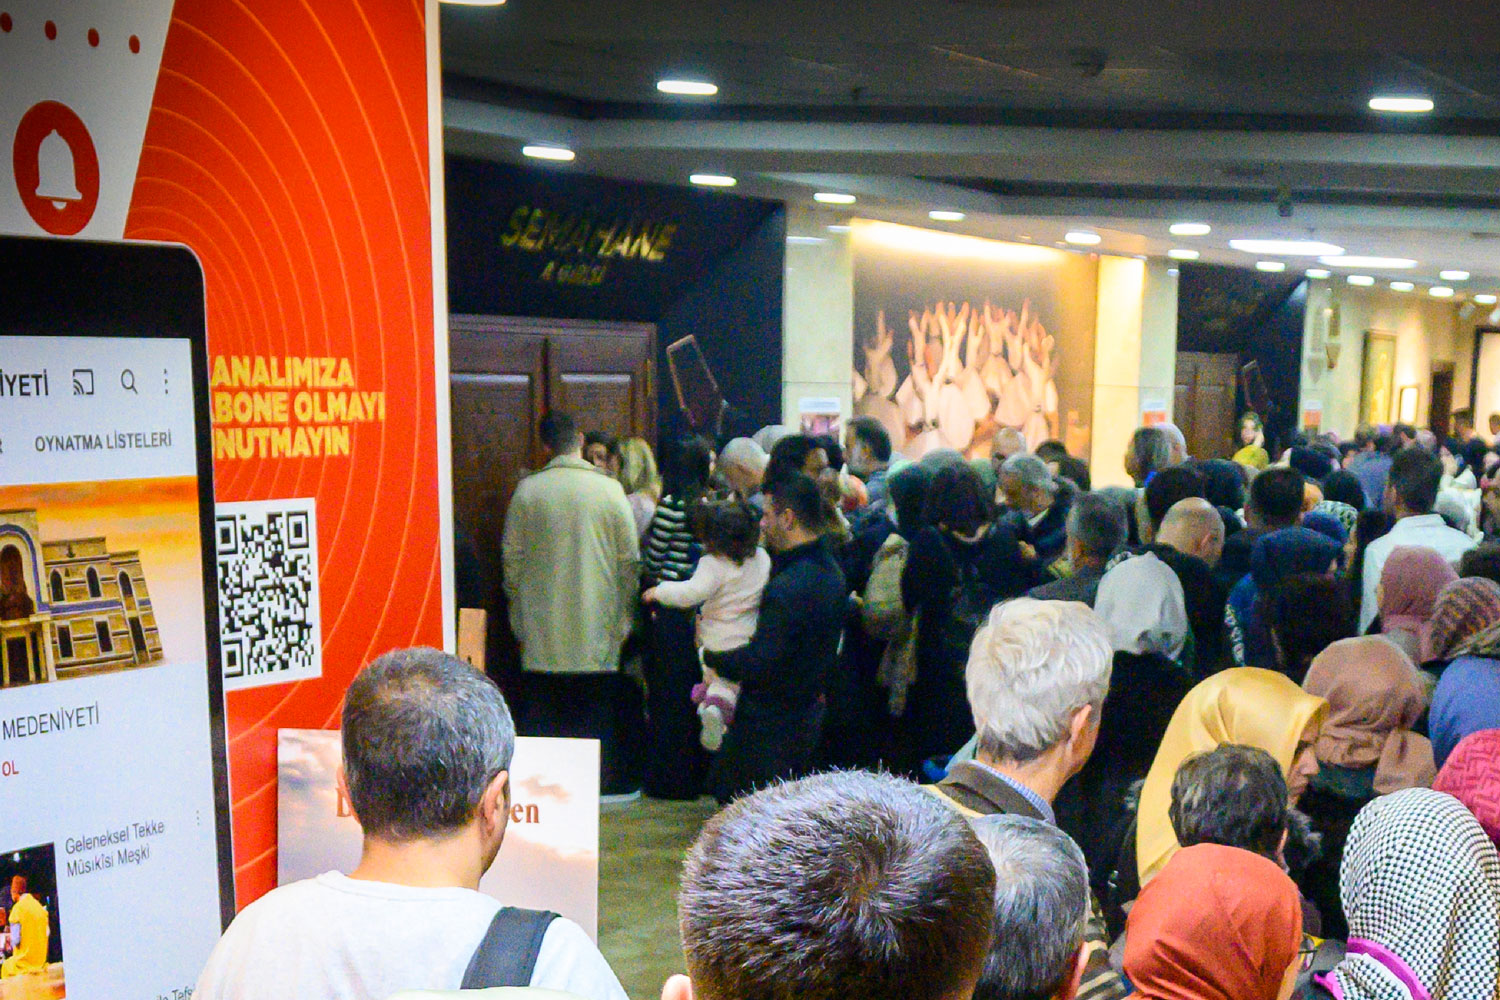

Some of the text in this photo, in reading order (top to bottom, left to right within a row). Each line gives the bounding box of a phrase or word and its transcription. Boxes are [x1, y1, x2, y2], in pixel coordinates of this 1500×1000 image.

[210, 355, 356, 387] ANALIMIZA
[211, 391, 385, 423] BONE OLMAYI
[35, 428, 172, 452] OYNATMA LİSTELERİ
[214, 425, 350, 459] NUTMAYIN
[2, 701, 100, 740] MEDENİYETİ
[2, 760, 20, 777] OL
[65, 820, 165, 855] Geleneksel Tekke
[117, 842, 151, 865] Meşki
